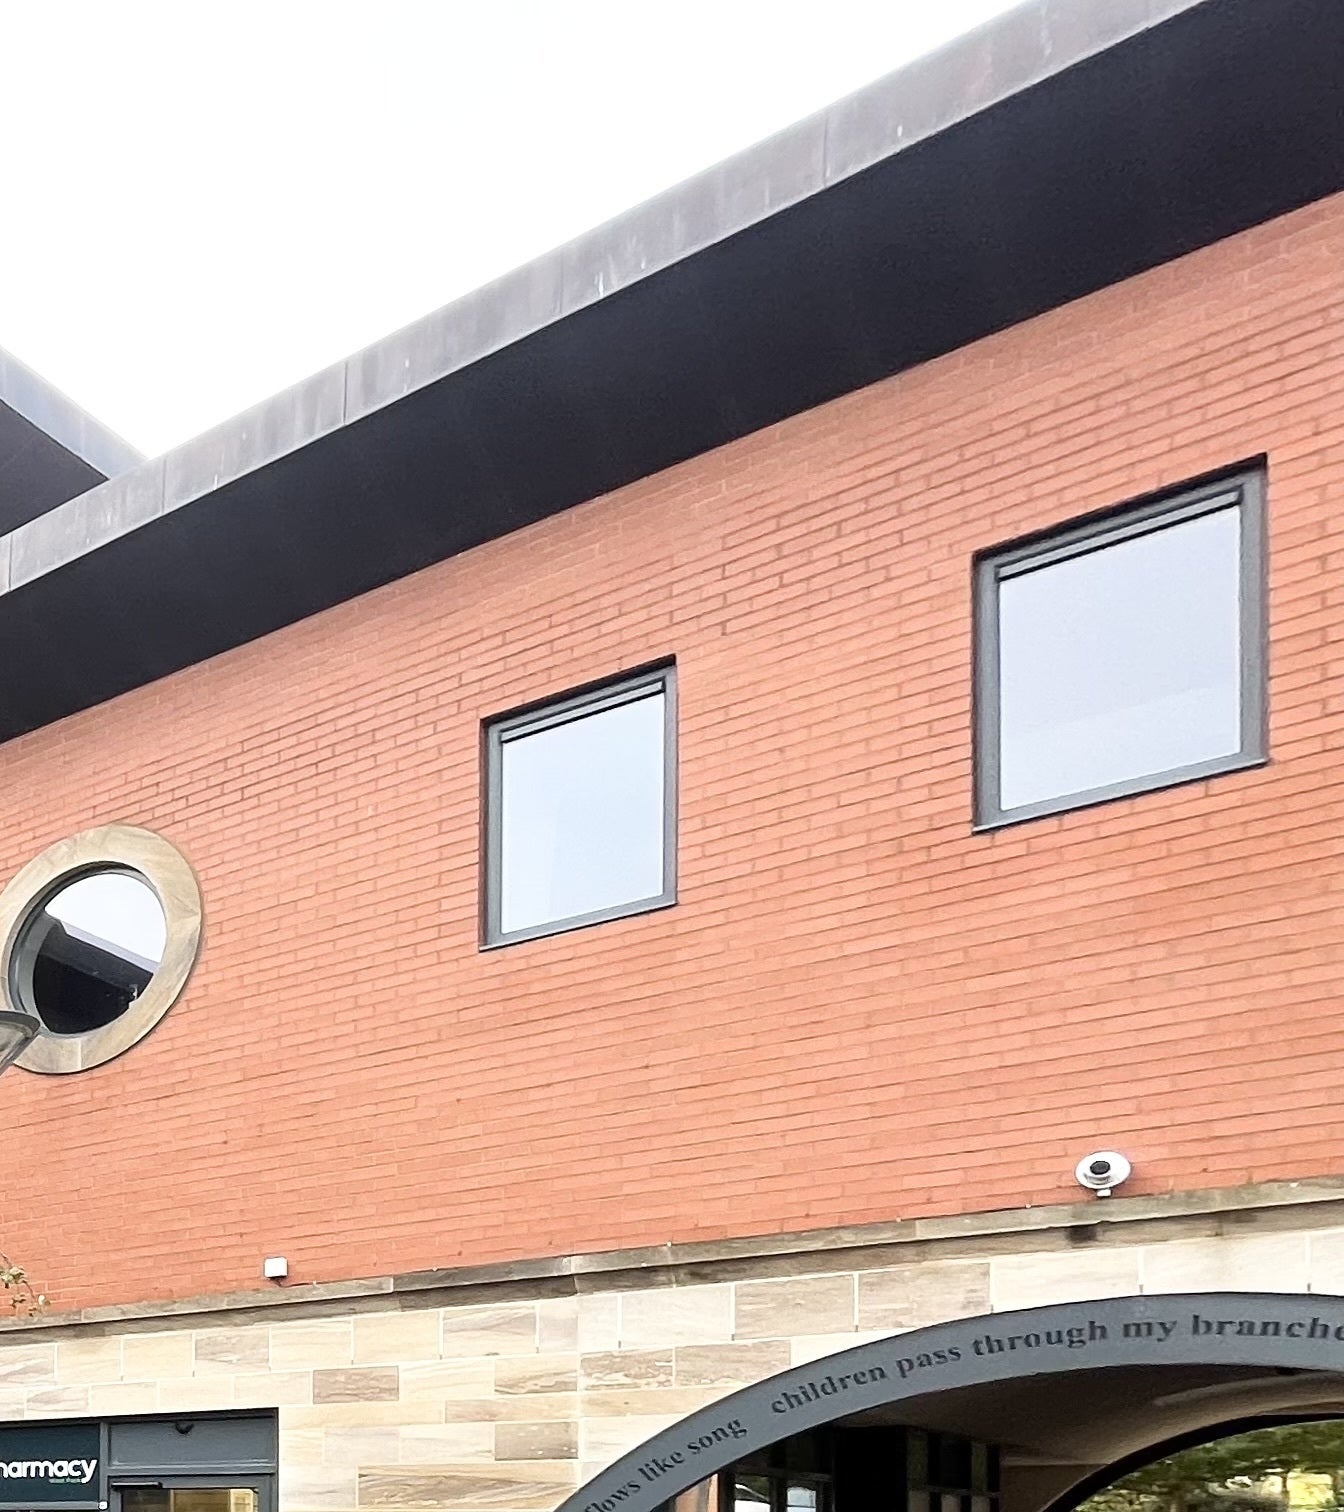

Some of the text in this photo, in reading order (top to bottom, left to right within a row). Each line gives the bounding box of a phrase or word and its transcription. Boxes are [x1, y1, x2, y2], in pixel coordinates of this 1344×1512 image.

[771, 1366, 889, 1414] children
[895, 1345, 962, 1378] pass
[972, 1320, 1109, 1356] through
[1122, 1320, 1178, 1342] my
[638, 1449, 686, 1482] like
[687, 1418, 748, 1455] song
